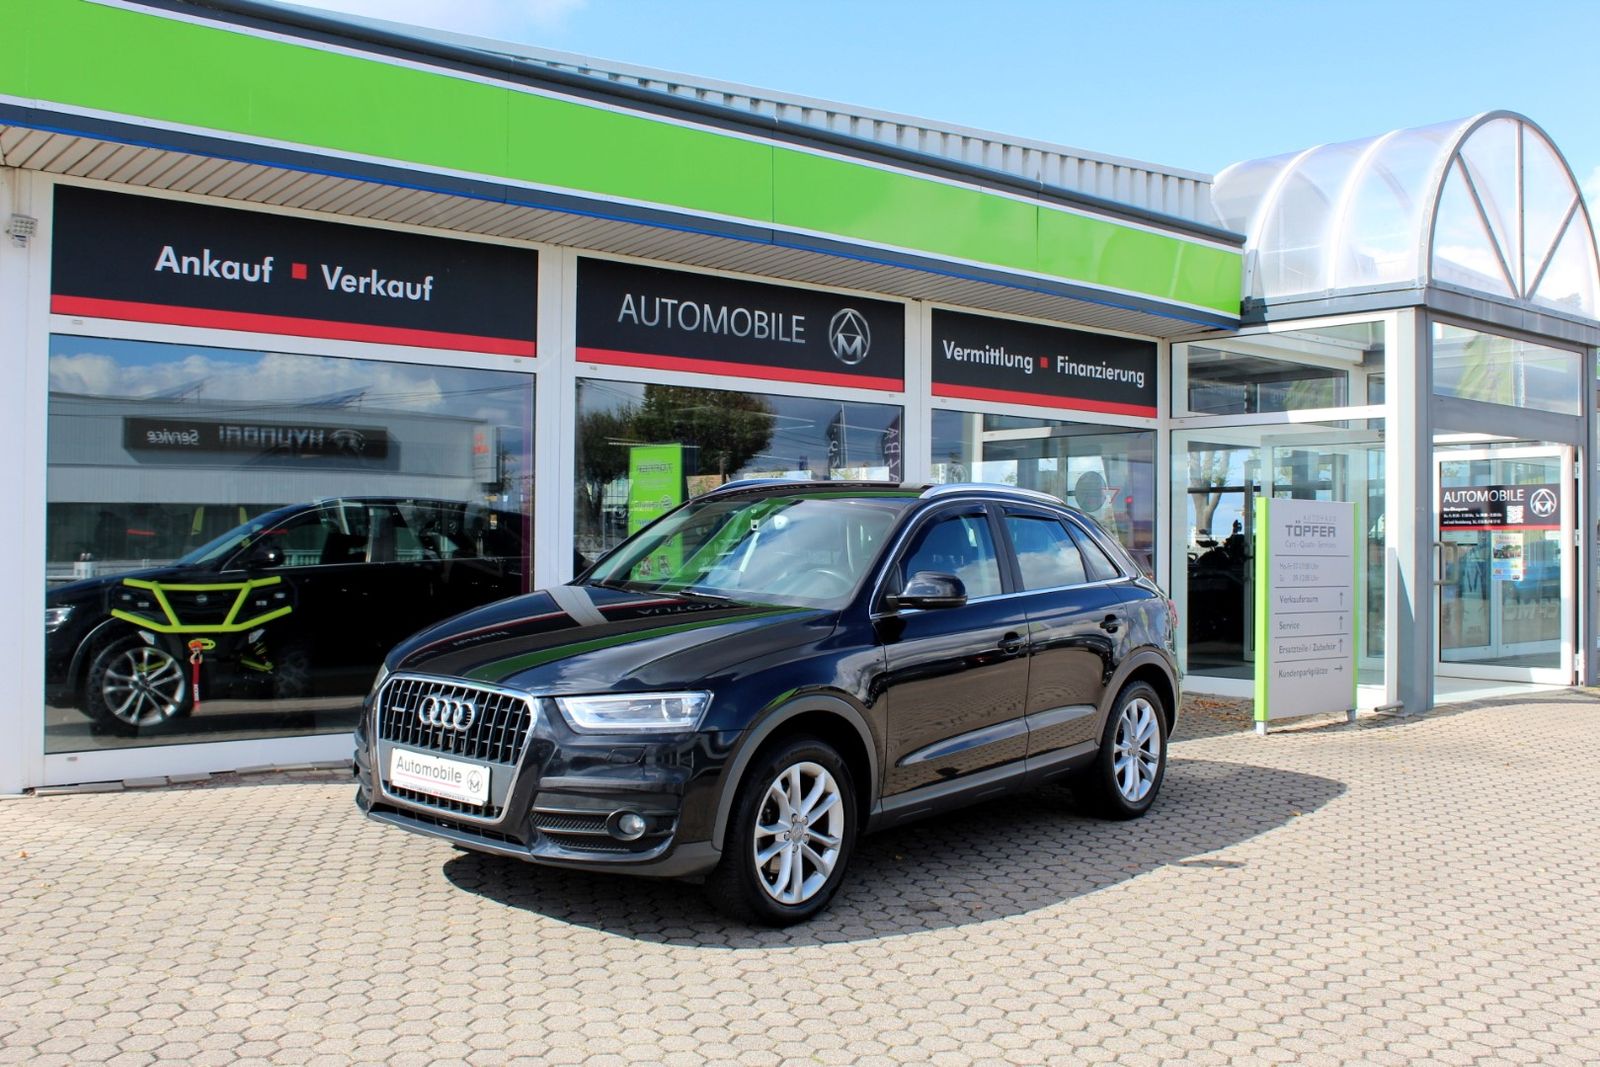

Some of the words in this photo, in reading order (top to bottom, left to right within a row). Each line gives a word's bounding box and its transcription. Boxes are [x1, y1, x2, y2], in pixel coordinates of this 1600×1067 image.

[154, 245, 274, 283] Ankauf
[320, 264, 434, 301] Verkauf
[617, 293, 806, 344] AUTOMOBILE
[942, 339, 1034, 374] Vermittlung
[1056, 355, 1145, 388] Finanzierung
[1443, 488, 1525, 504] AUTOMOBILE
[1285, 519, 1337, 538] TÖPFER
[1278, 620, 1301, 631] Service
[396, 756, 462, 784] Automobile
